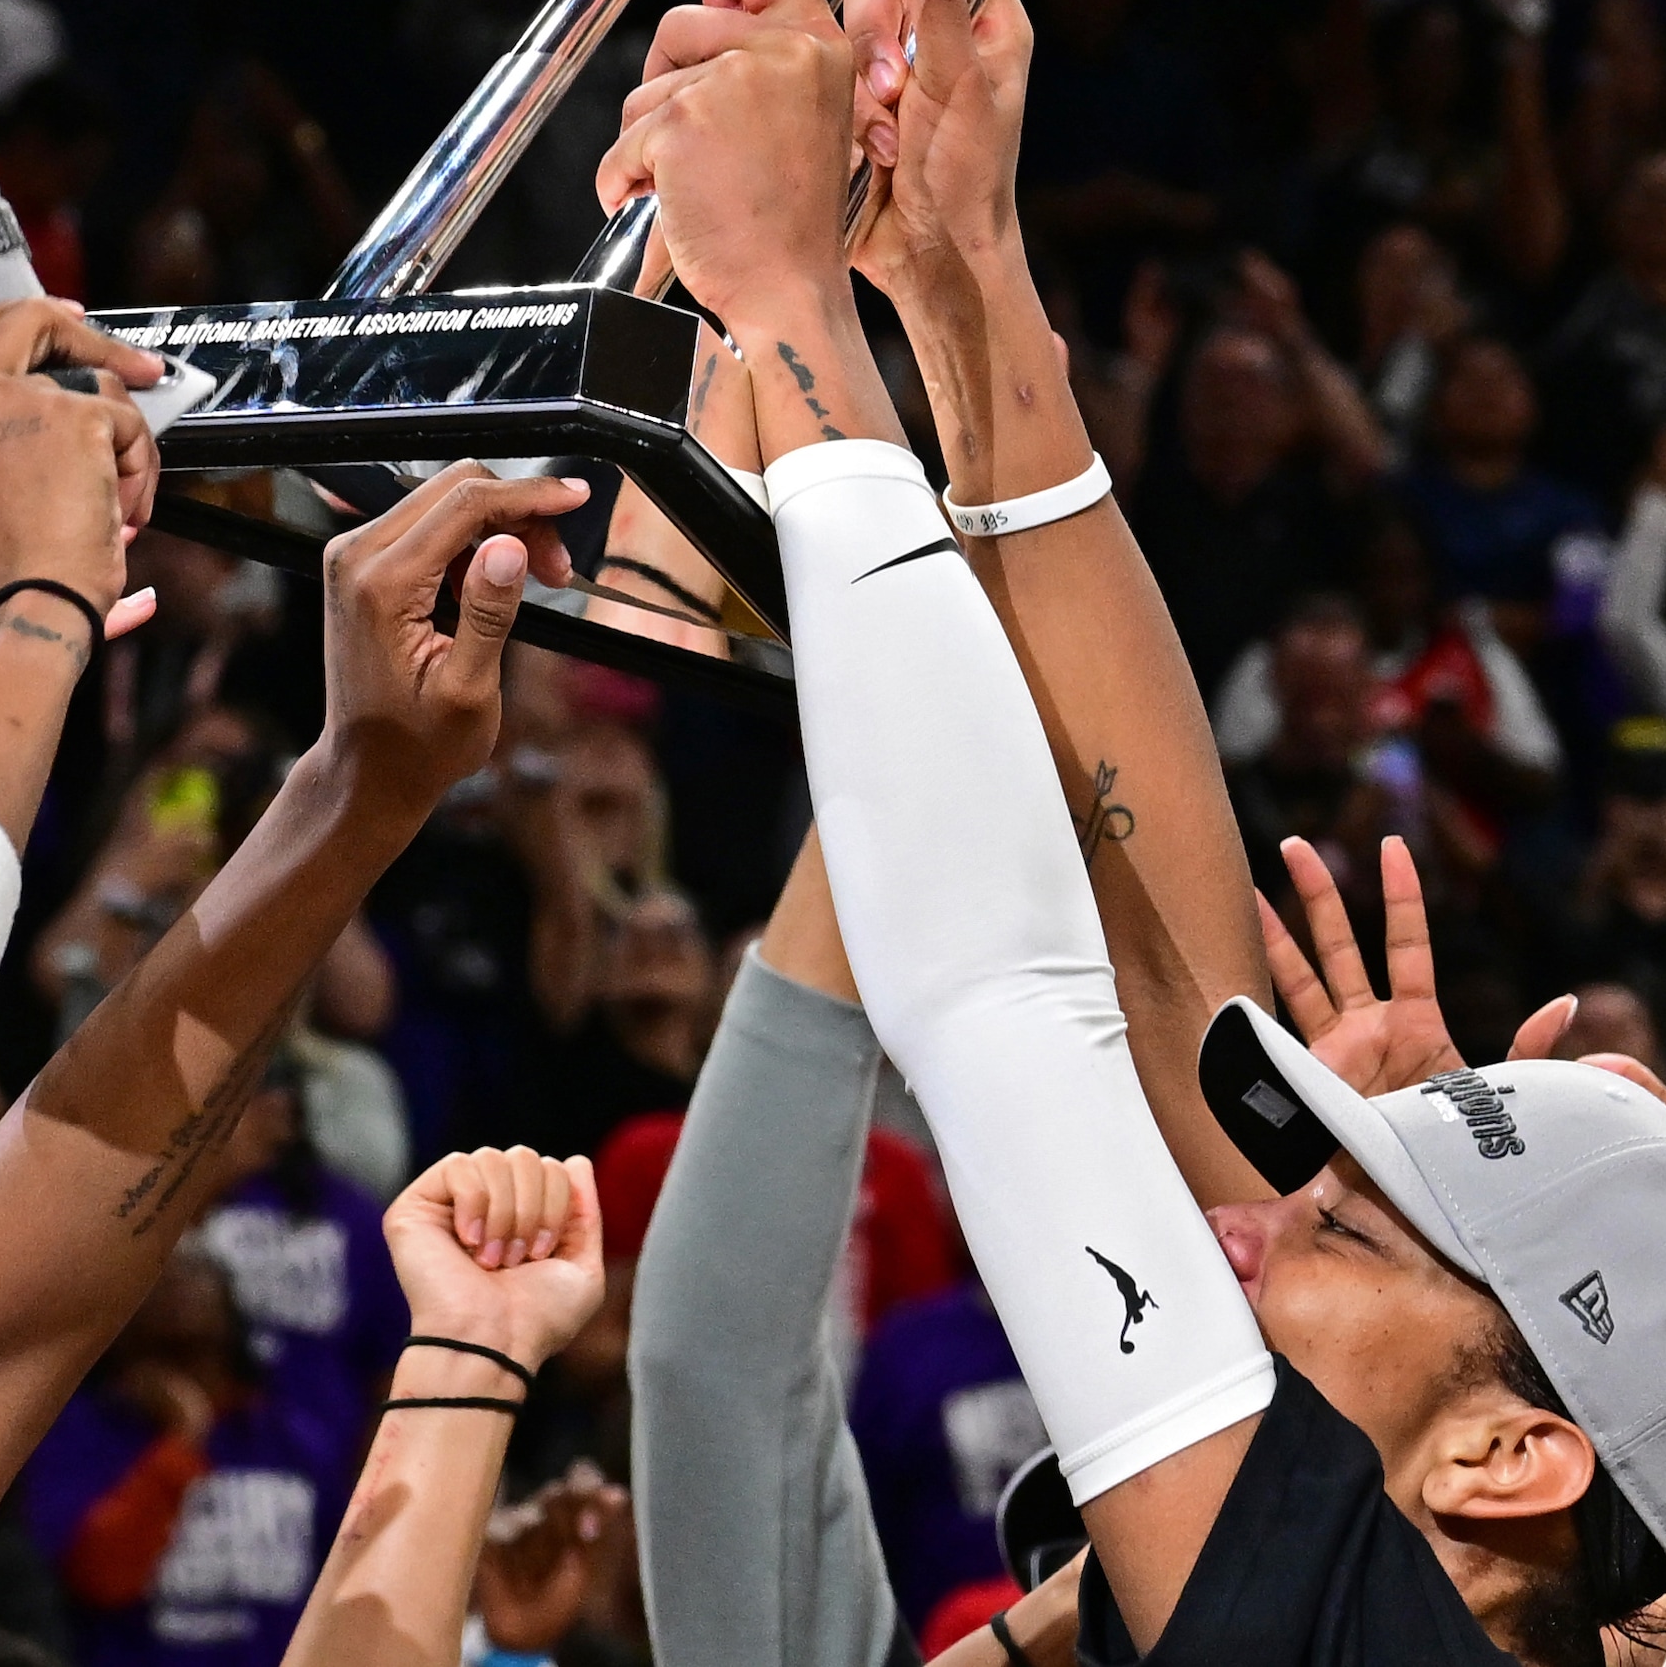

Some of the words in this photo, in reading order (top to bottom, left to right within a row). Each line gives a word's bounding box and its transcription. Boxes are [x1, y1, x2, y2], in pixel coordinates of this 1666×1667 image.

[167, 320, 252, 345] NATIONAL
[249, 315, 355, 341] BASKETBALL
[353, 308, 473, 336] ASSOCIATION
[470, 302, 579, 330] CHAMPIONS
